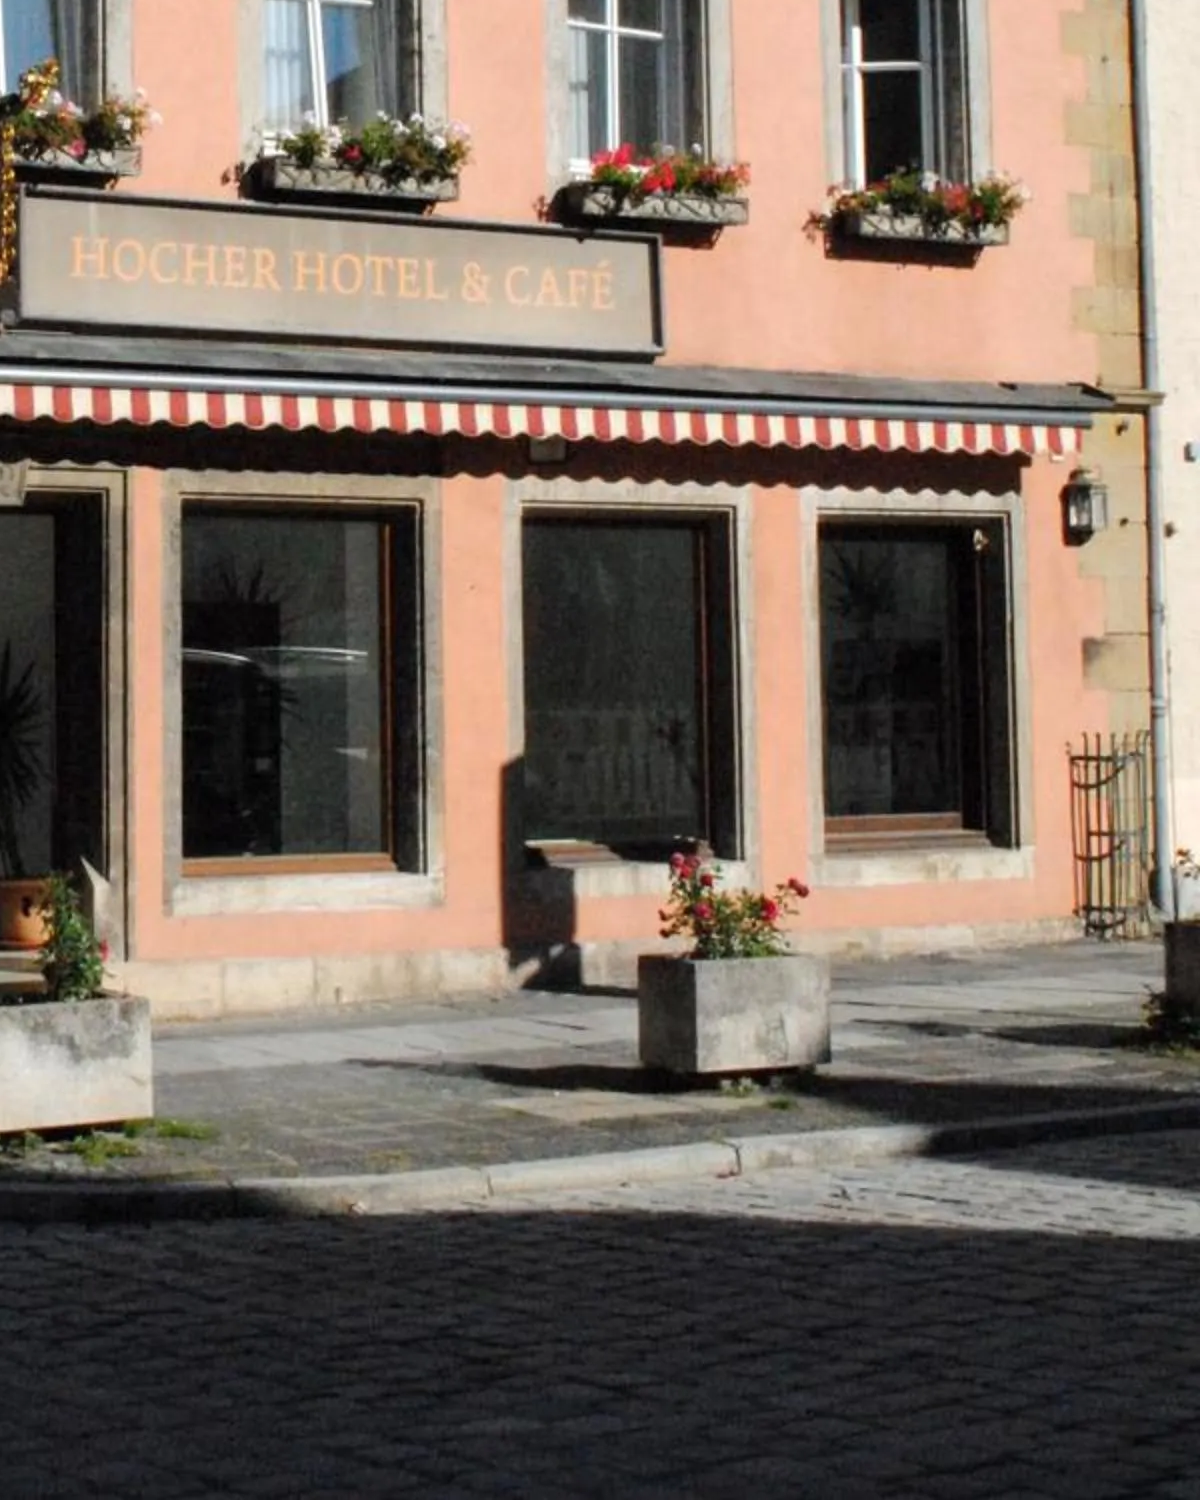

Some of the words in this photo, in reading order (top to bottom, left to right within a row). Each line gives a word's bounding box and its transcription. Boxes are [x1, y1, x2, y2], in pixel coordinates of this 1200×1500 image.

[69, 235, 281, 291] HOCHER
[293, 250, 448, 301] HOTEL
[461, 260, 491, 306] &
[504, 259, 615, 310] CAFÉ
